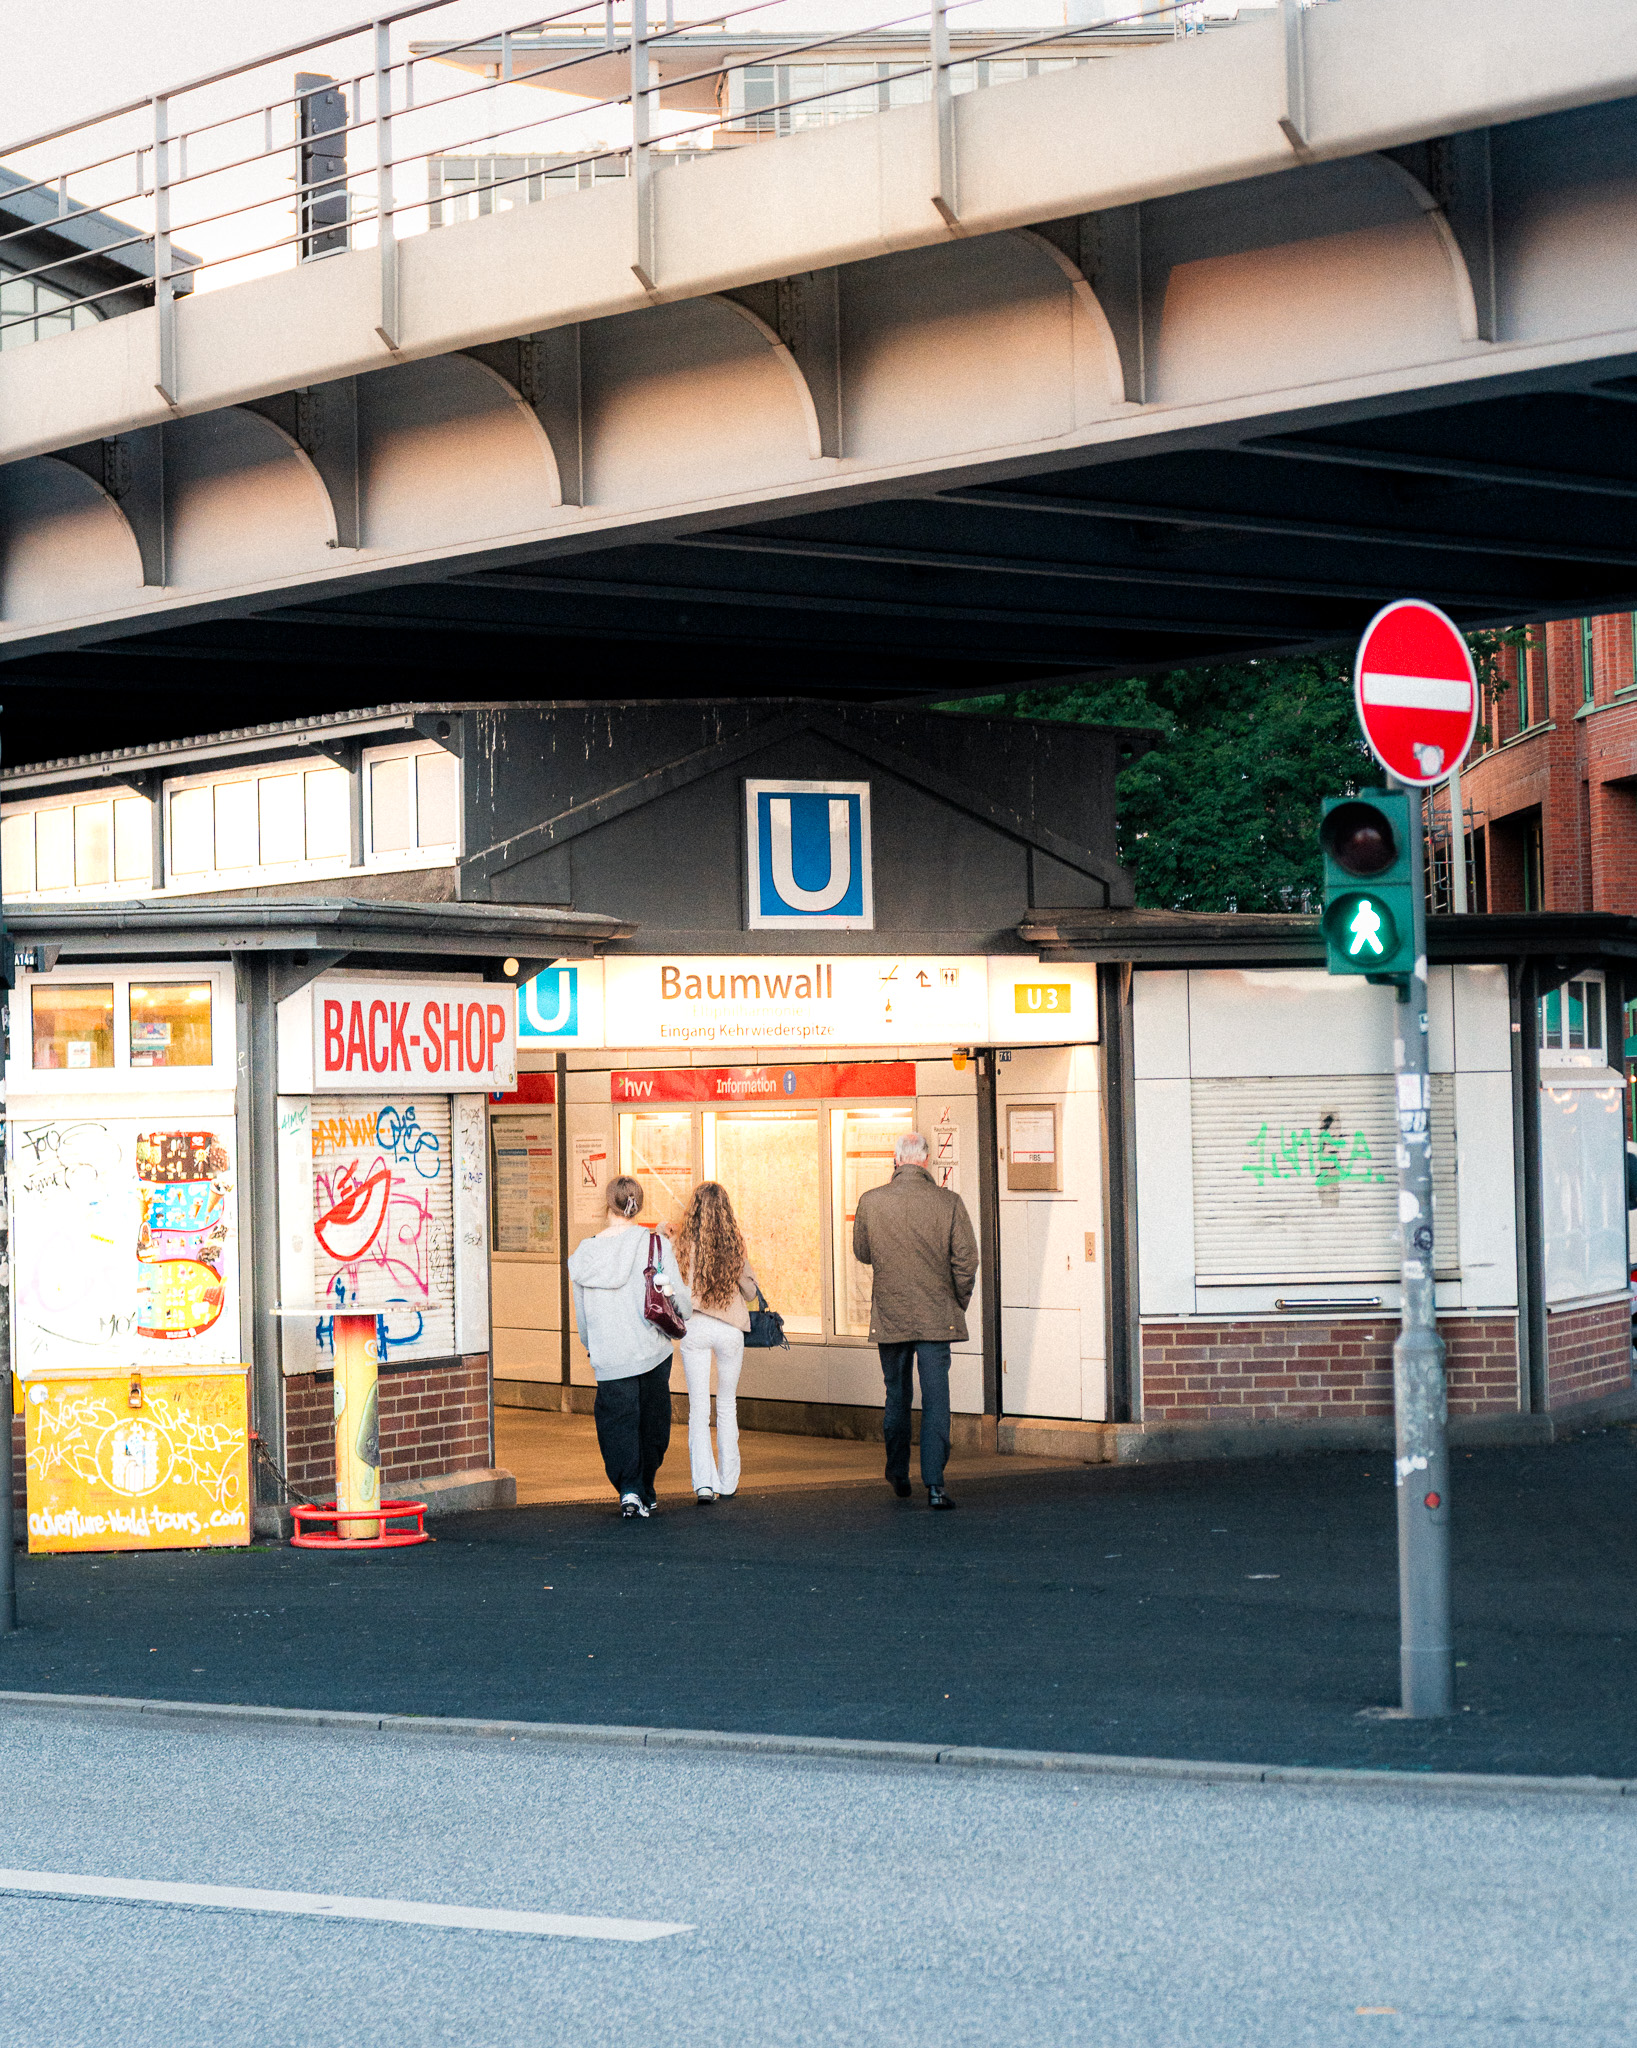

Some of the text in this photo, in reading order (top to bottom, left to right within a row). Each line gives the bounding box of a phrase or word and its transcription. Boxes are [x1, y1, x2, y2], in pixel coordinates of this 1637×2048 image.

[770, 798, 852, 913] U
[661, 963, 833, 1000] Baumwall
[525, 970, 571, 1033] U
[324, 1000, 506, 1073] BACK-SHOP
[660, 1023, 835, 1041] Eingang Kehrwiederspitze
[624, 1077, 653, 1097] hvv
[716, 1078, 777, 1094] Information
